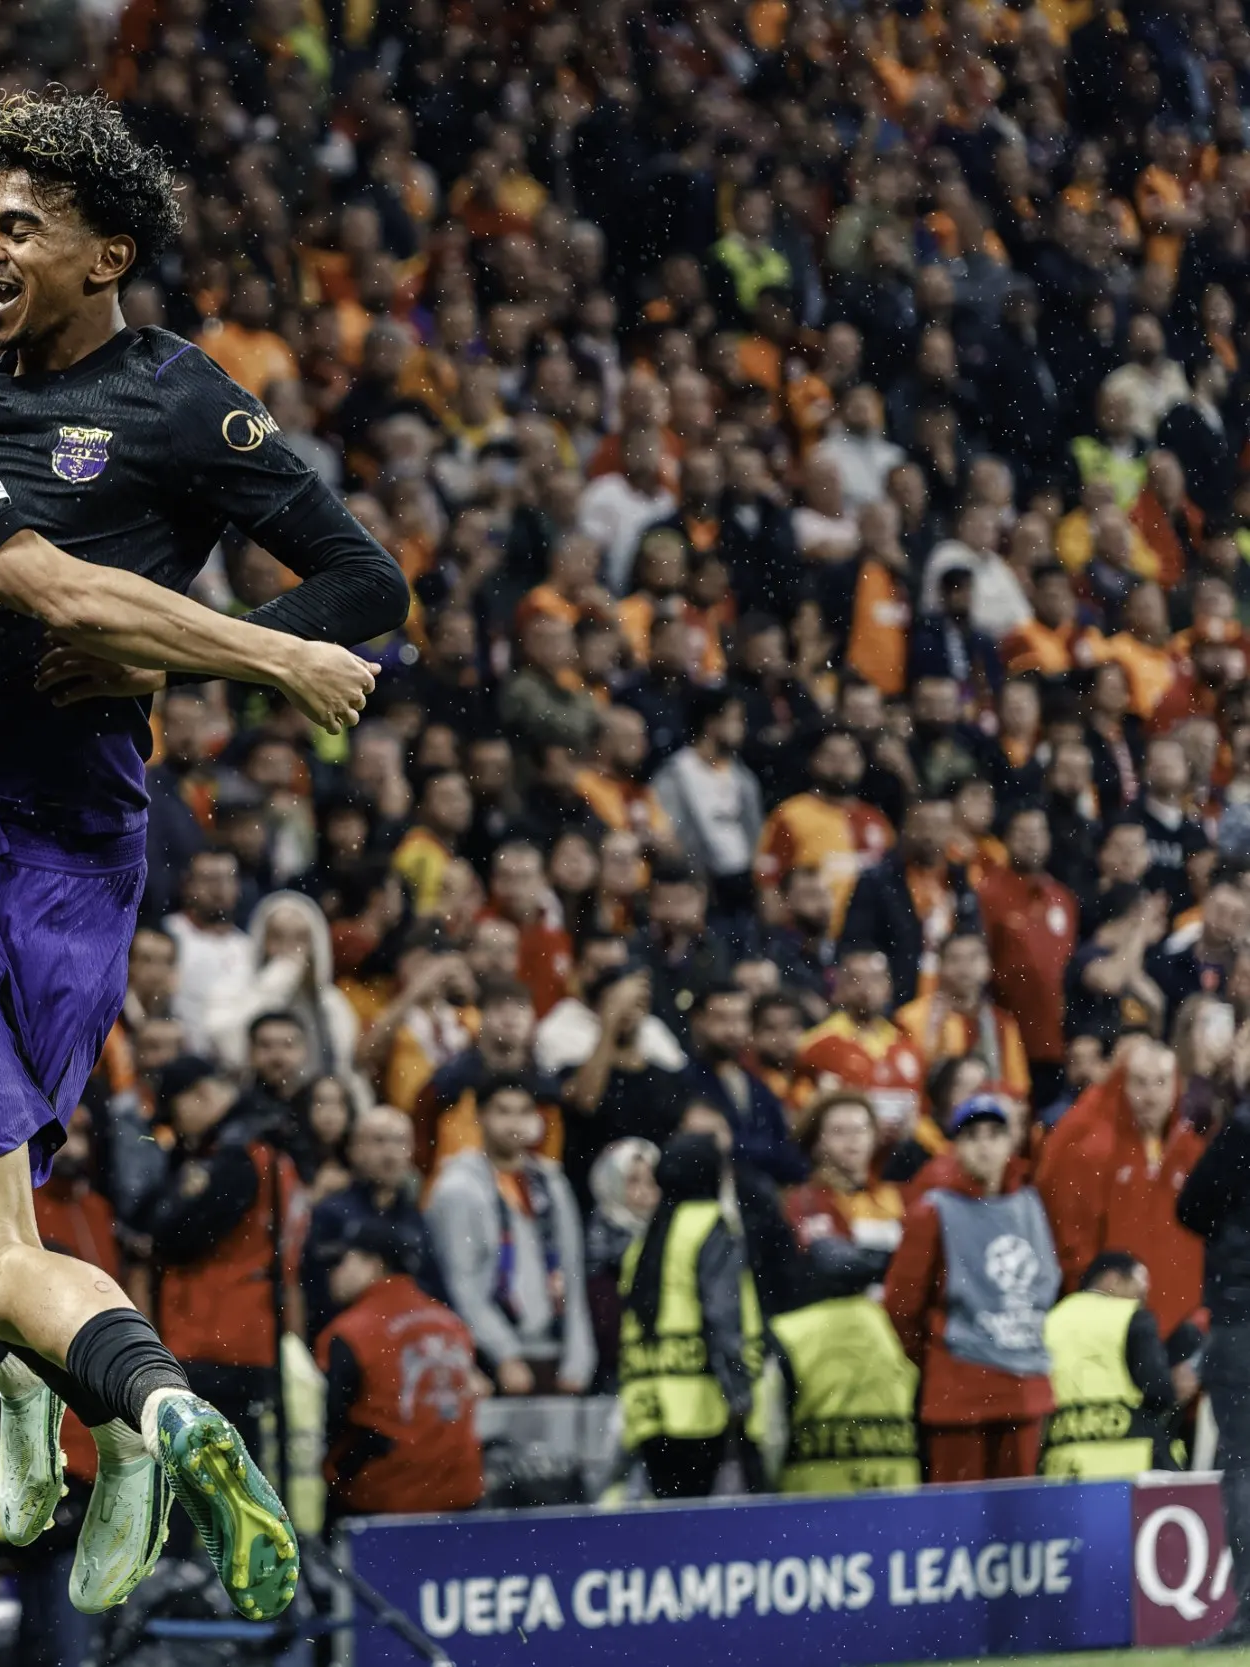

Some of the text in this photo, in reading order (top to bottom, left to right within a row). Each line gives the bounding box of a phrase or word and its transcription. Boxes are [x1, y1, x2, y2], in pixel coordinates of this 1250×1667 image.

[419, 1538, 1073, 1638] UEFA CHAMPIONS LEAGUE
[1134, 1504, 1233, 1622] Q
